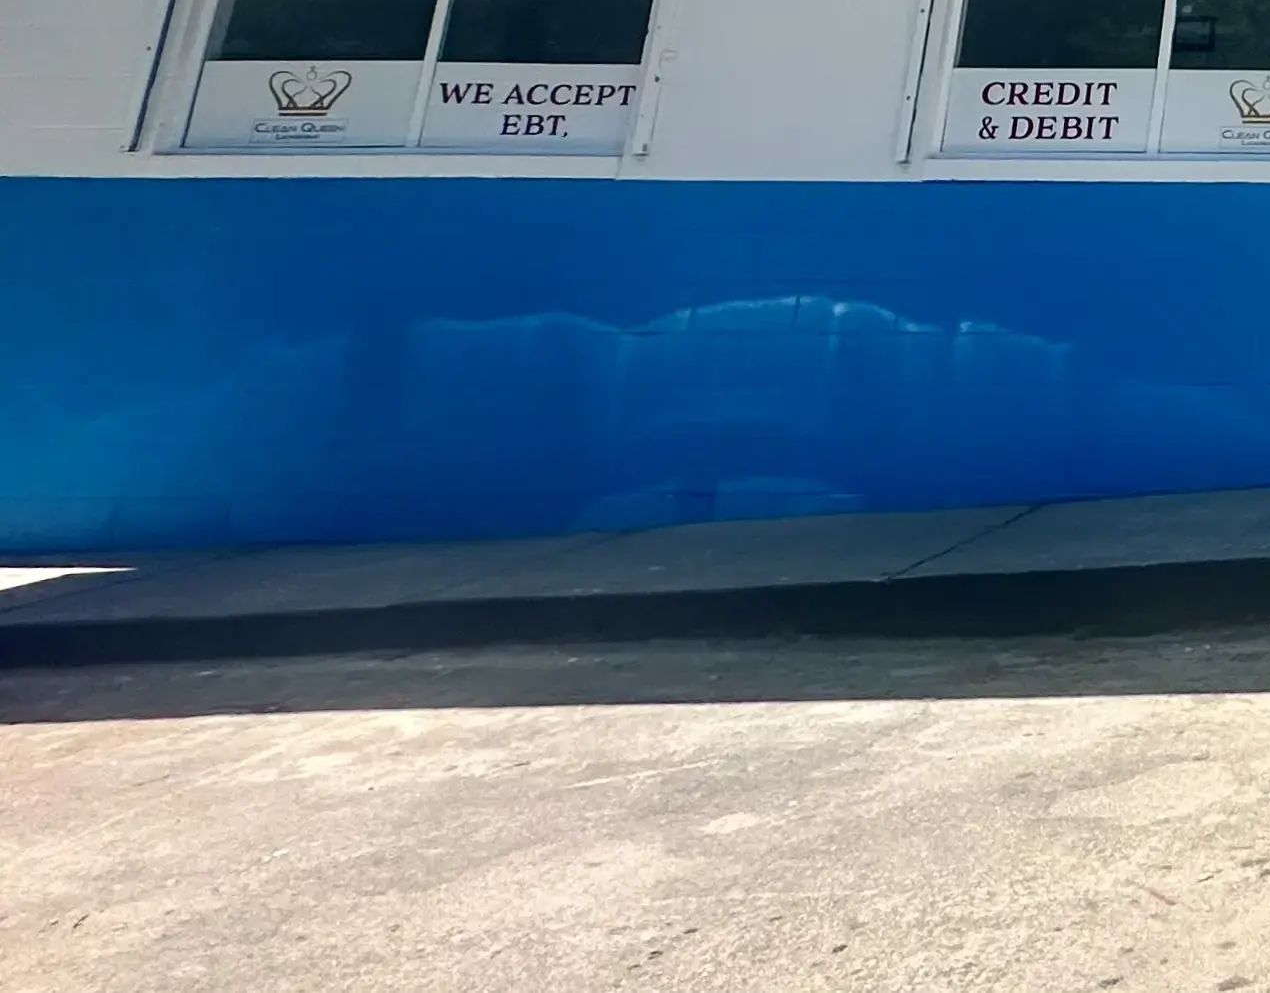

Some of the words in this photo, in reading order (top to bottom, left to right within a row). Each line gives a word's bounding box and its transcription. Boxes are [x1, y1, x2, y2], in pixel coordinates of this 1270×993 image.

[439, 82, 495, 105] WE
[500, 83, 637, 107] ACCEPT
[981, 81, 1118, 105] CREDIT
[500, 113, 569, 138] EBT,
[978, 115, 1000, 140] &
[1007, 115, 1120, 140] DEBIT
